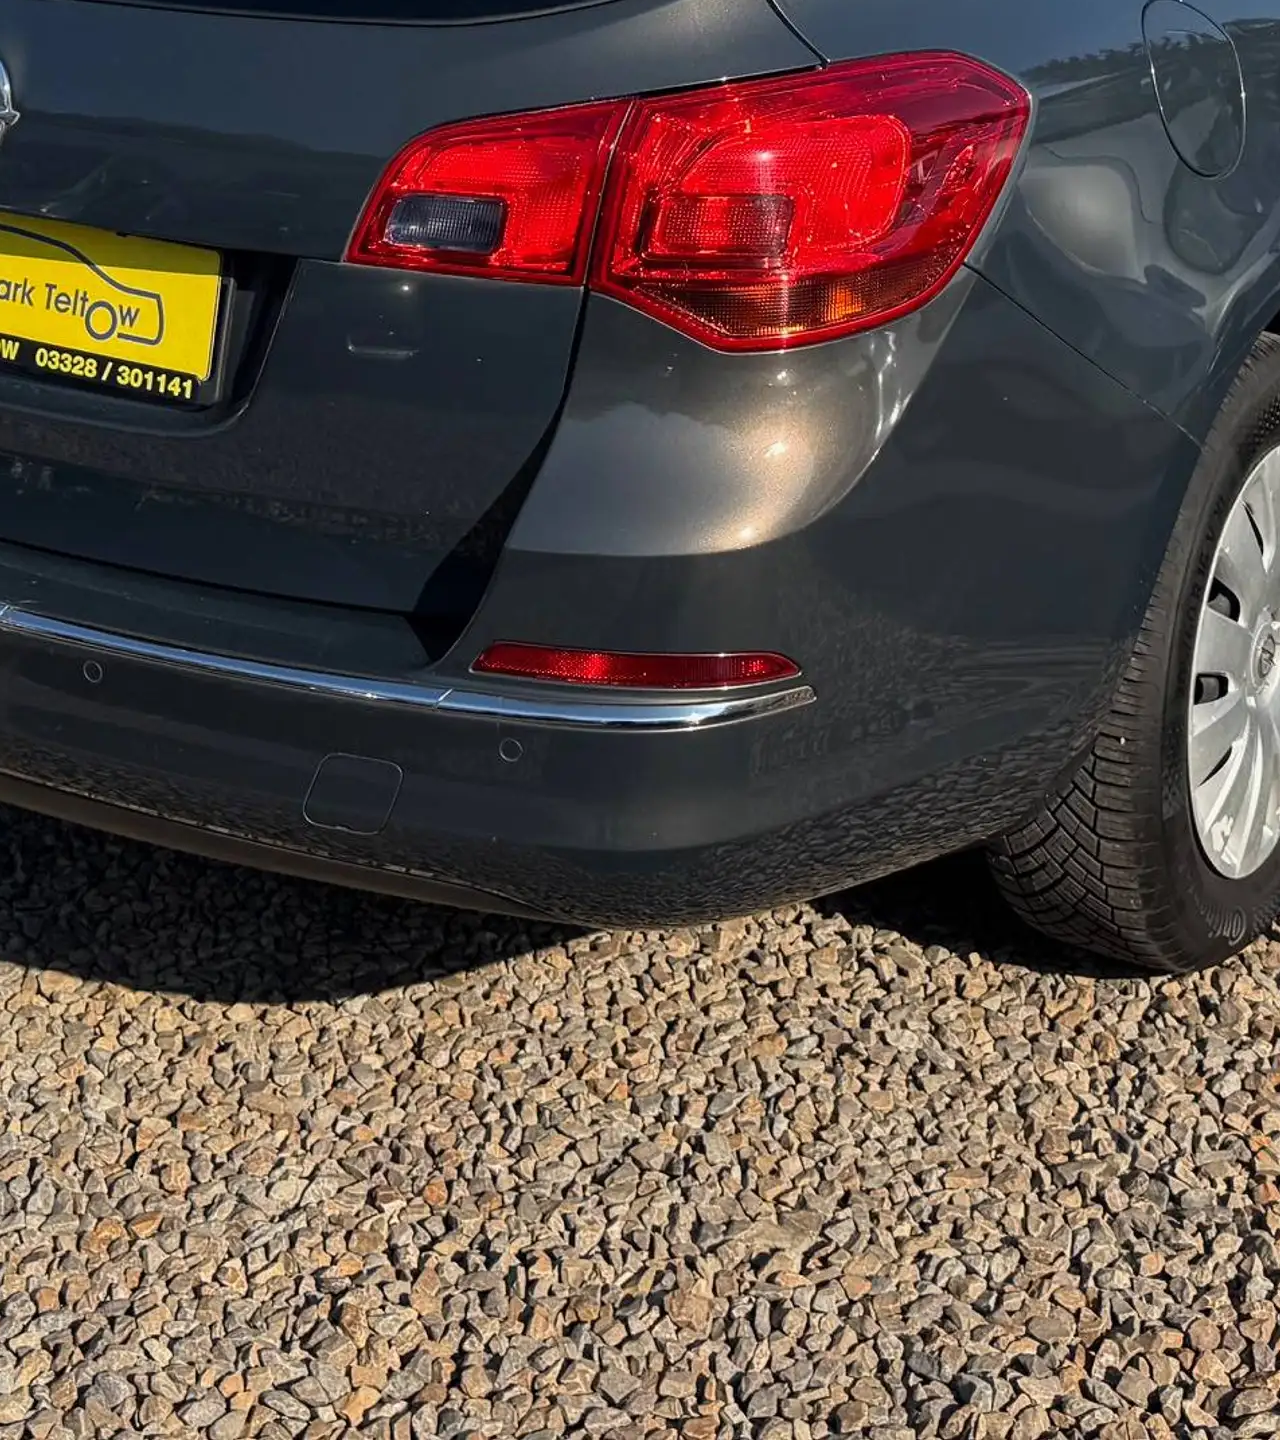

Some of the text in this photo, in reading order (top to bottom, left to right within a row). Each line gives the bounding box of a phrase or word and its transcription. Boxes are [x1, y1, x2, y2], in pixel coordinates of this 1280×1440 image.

[44, 282, 140, 341] Teltow
[35, 347, 98, 379] 03328
[100, 358, 112, 381] /
[116, 366, 194, 400] 301141
